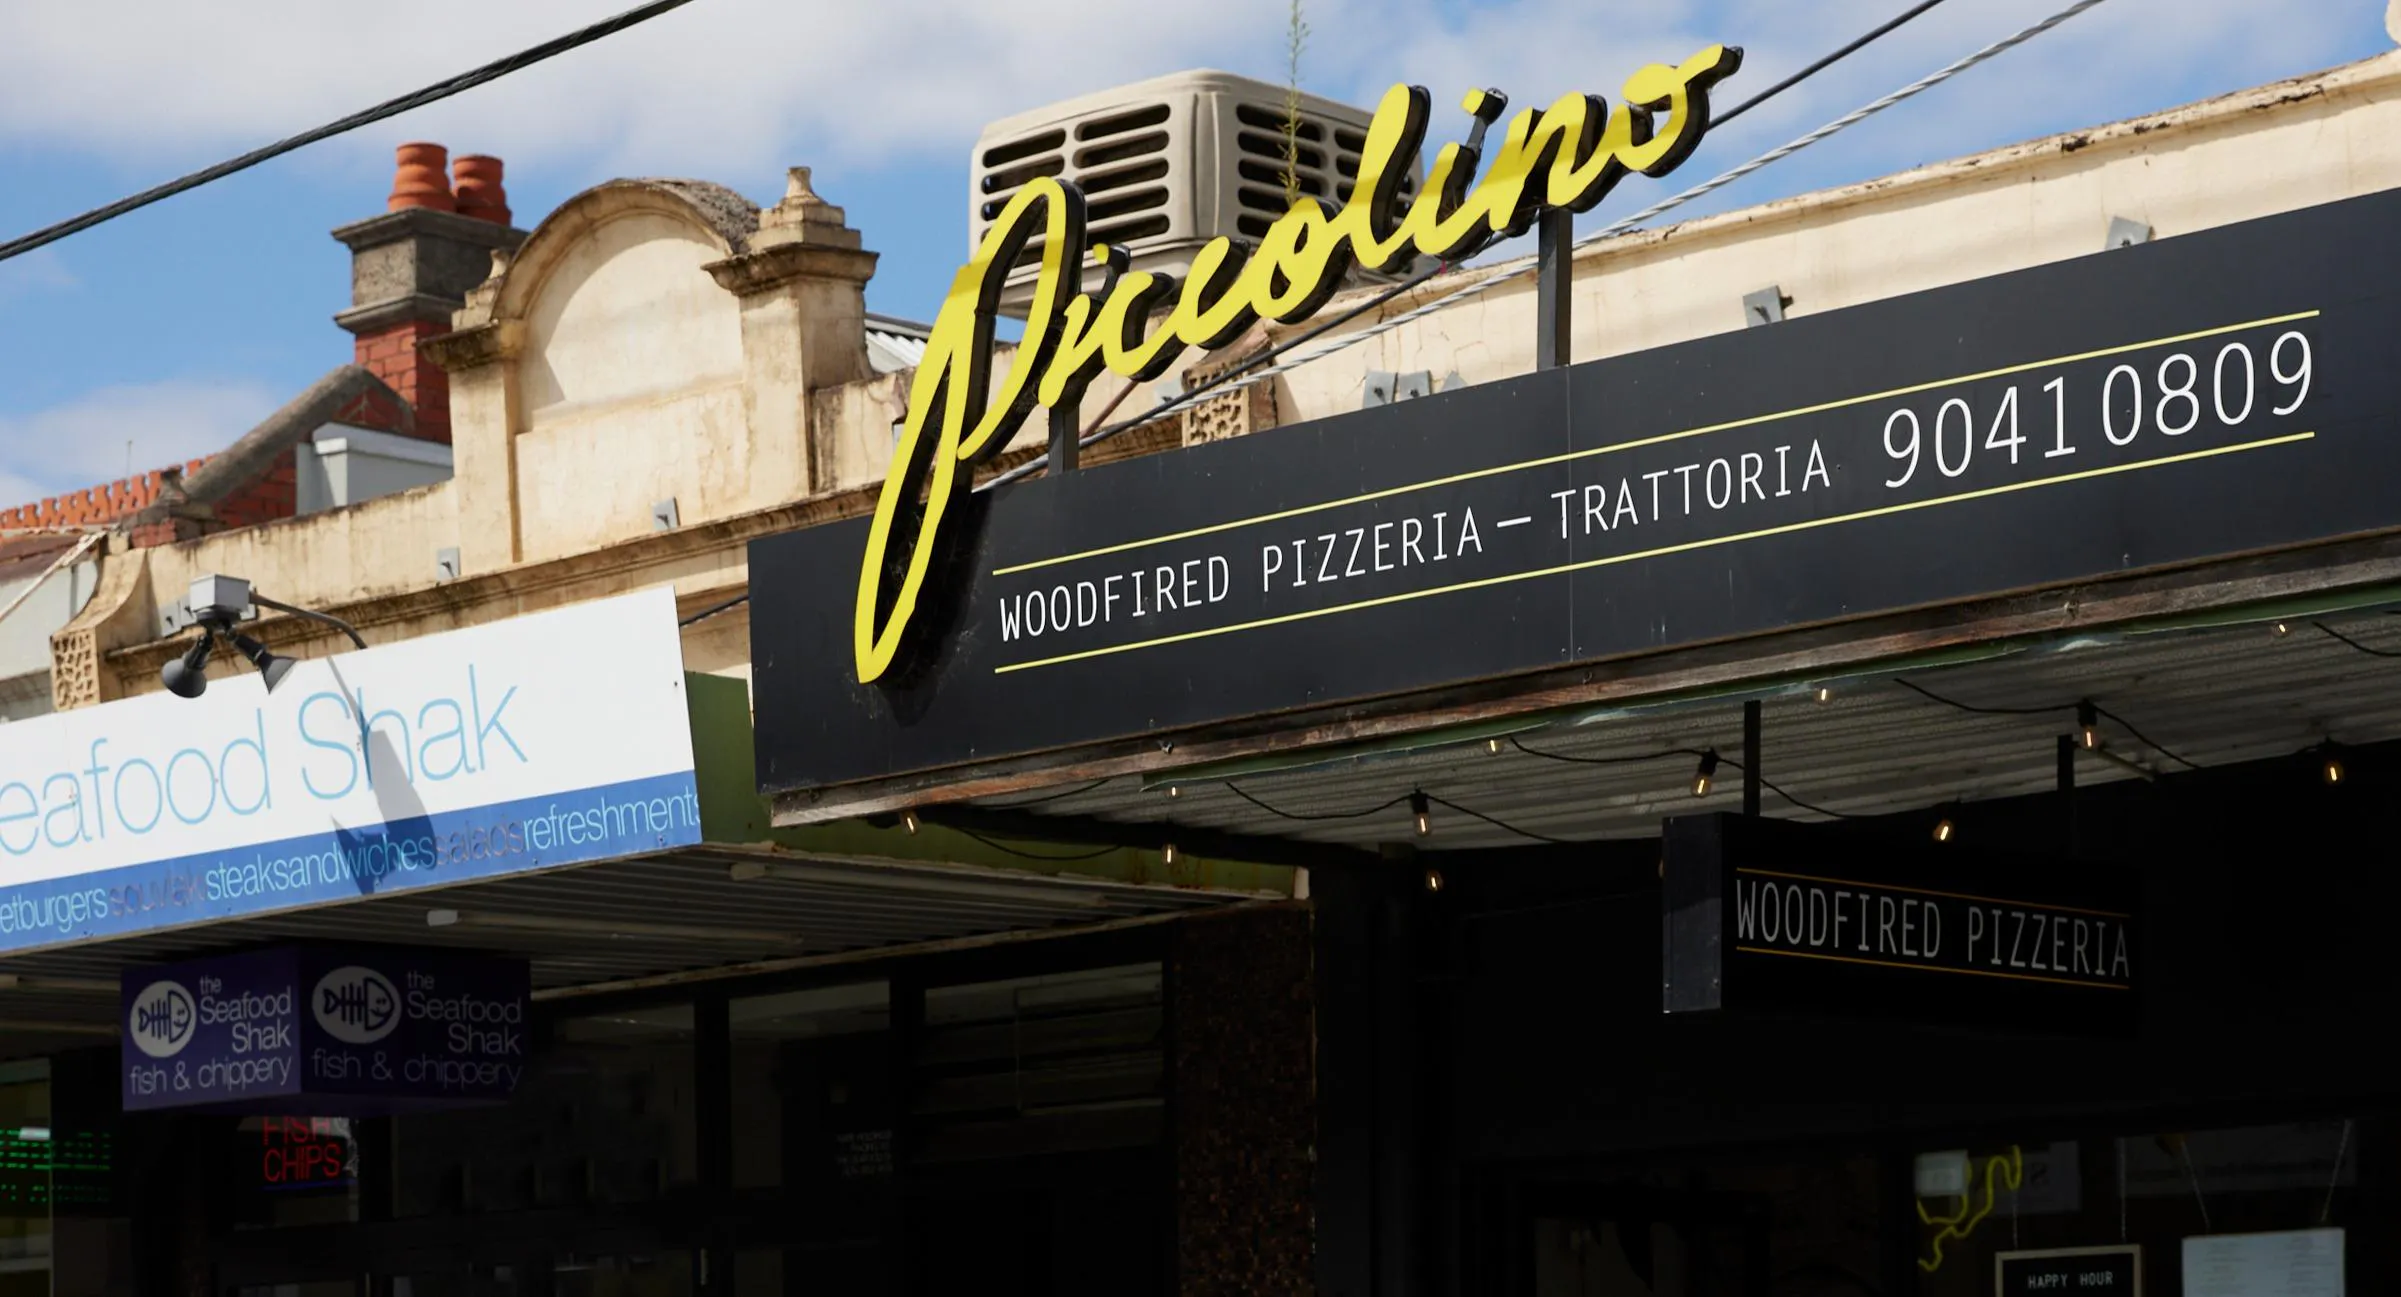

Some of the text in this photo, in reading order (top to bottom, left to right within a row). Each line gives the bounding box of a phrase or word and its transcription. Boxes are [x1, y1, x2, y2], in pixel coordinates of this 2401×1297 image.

[854, 43, 1741, 684] Piccolino
[999, 555, 1230, 642] WOODFIRED
[1263, 506, 1483, 593] PIZZERIA
[1550, 438, 1831, 540] TRATTORIA
[298, 663, 529, 801] Shak
[1736, 878, 2131, 979] WOODFIRED PIZZERIA
[200, 974, 223, 995] the
[406, 970, 436, 990] the
[200, 985, 292, 1025] Seafood
[406, 990, 523, 1025] Seafood
[231, 1018, 292, 1054] Shak
[447, 1023, 523, 1057] Shak
[129, 1053, 292, 1096] fish & chippery
[310, 1047, 523, 1093] fish & chippery
[262, 1139, 343, 1183] CHIPS
[2026, 1270, 2114, 1290] HAPPY HOUR
